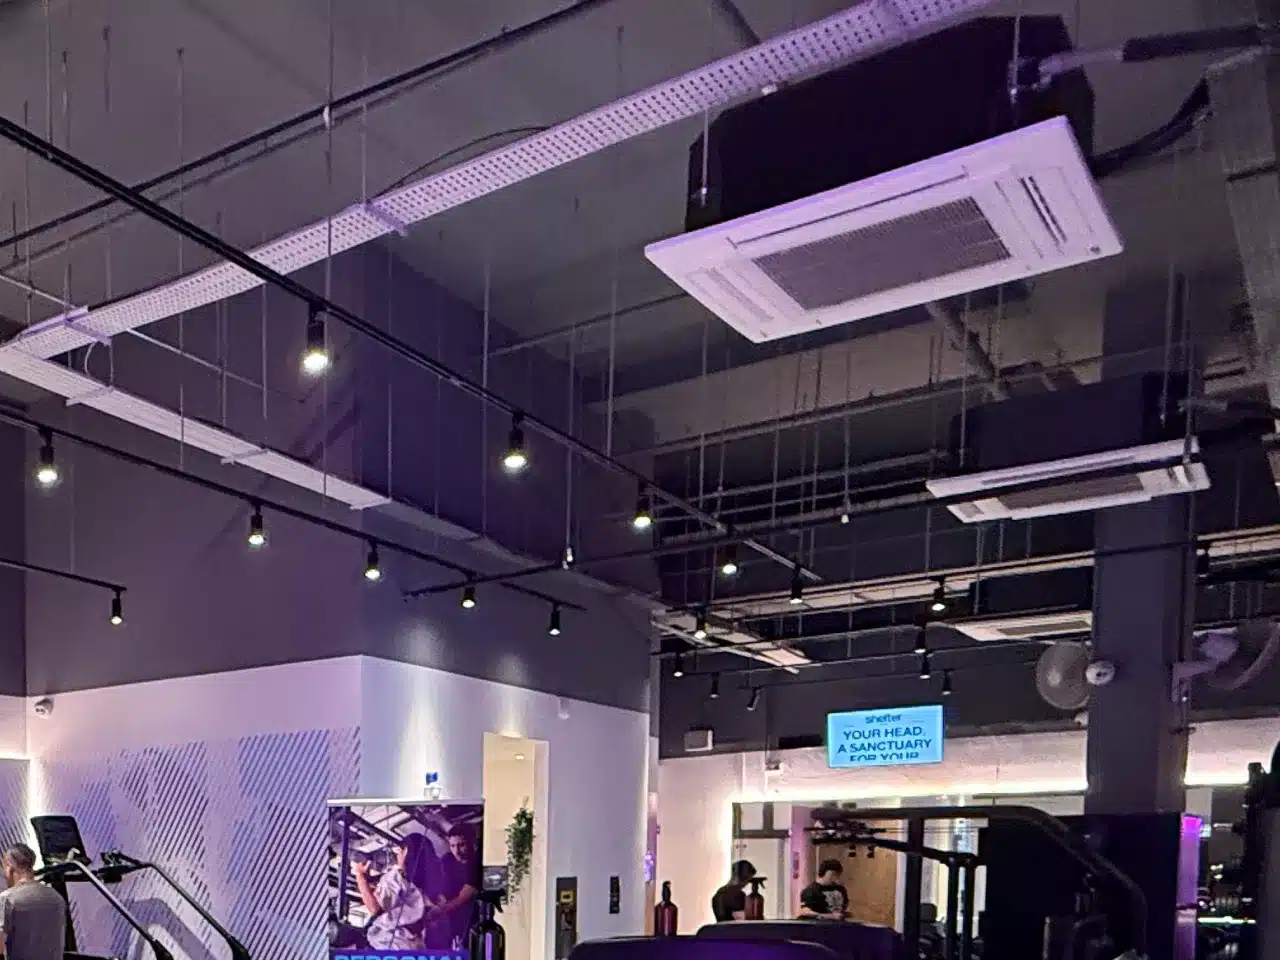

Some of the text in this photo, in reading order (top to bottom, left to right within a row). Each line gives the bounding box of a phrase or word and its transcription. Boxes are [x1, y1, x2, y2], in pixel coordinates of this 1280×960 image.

[865, 714, 902, 724] shelter
[843, 729, 881, 740] YOUR
[837, 739, 932, 753] A SANCTUARY
